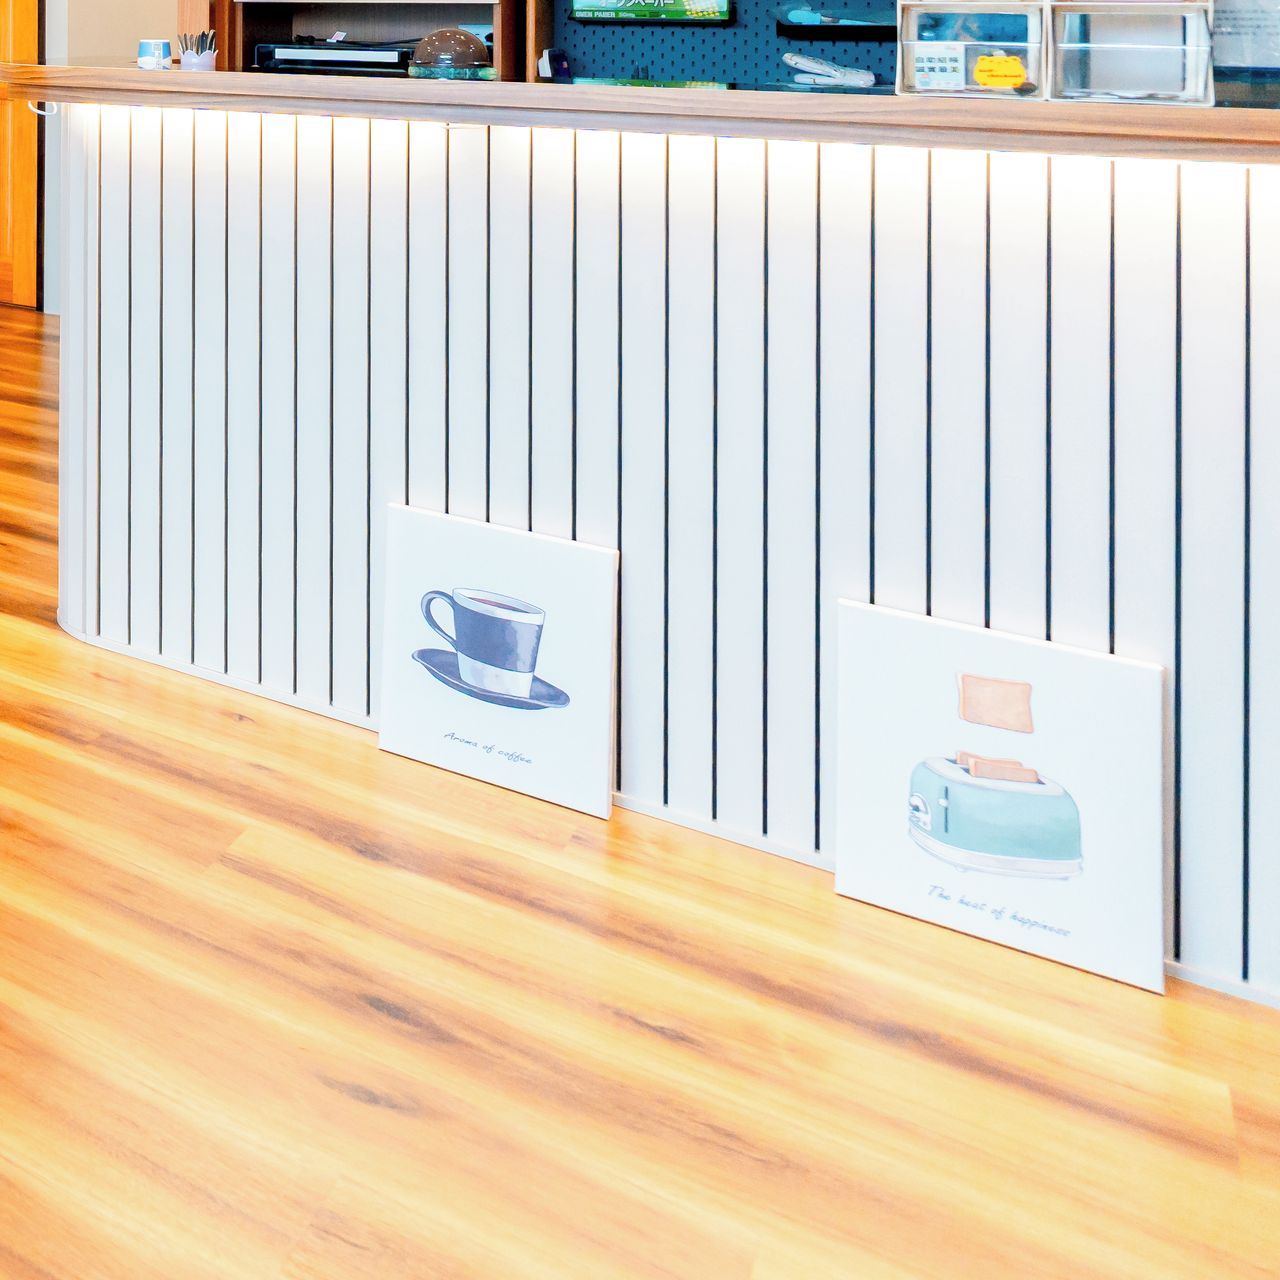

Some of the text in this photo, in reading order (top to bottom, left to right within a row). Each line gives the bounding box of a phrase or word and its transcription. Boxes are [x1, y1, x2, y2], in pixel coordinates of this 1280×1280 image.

[444, 732, 532, 764] Aroma of coffee
